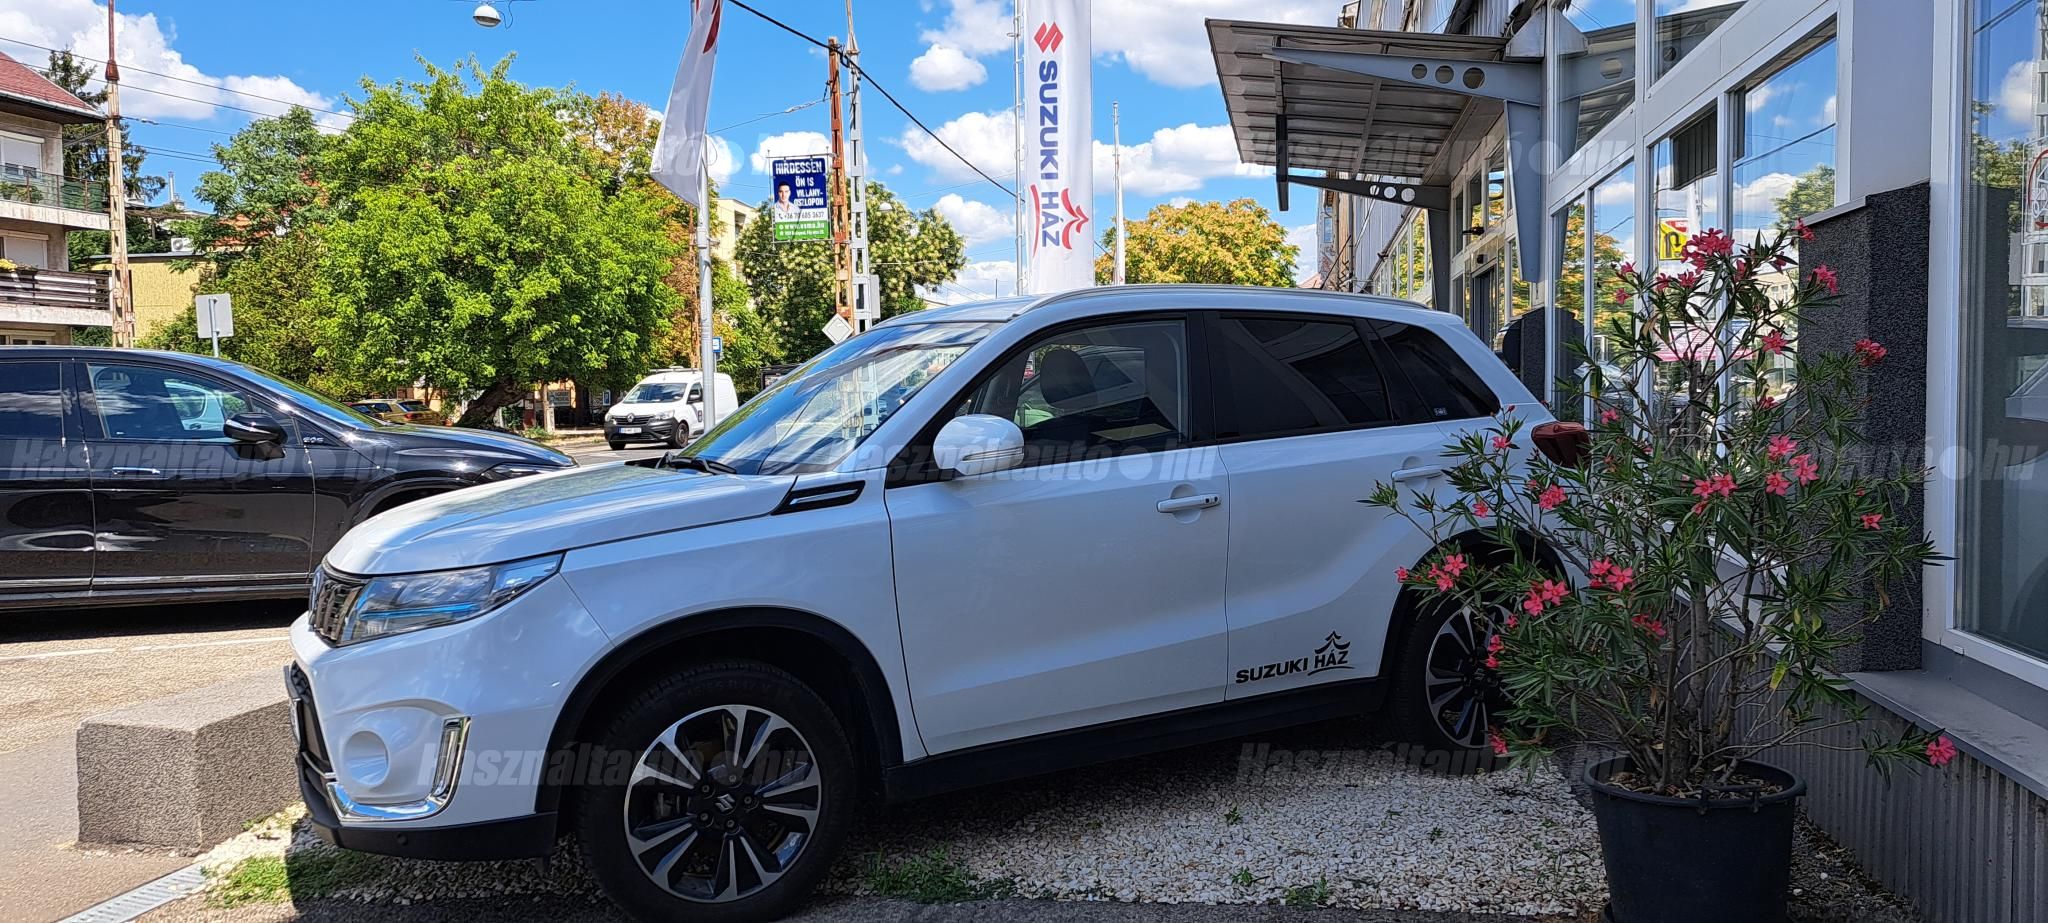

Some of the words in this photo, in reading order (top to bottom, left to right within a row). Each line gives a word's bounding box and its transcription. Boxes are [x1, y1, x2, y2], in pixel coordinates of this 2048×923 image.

[1039, 60, 1058, 180] SUZUKI
[775, 161, 823, 175] HIRDESSEN
[795, 175, 806, 187] ÖN
[807, 176, 815, 187] IS
[1041, 191, 1063, 247] HÁZ
[1235, 657, 1309, 684] SUZUKI
[1313, 649, 1349, 669] HÁZ
